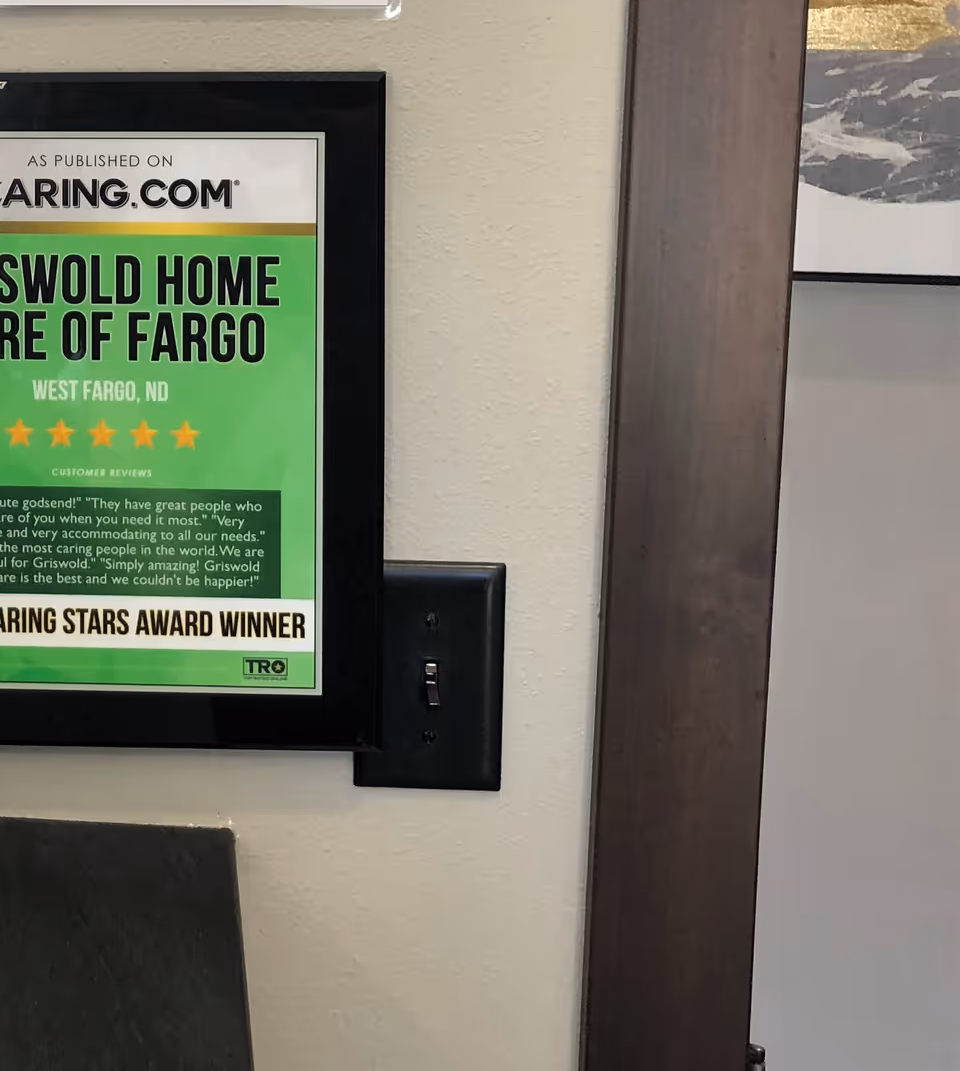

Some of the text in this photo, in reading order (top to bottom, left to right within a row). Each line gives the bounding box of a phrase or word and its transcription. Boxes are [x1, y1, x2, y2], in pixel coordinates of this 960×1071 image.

[28, 155, 173, 167] AS PUBLISHED ON
[156, 254, 280, 306] HOME
[61, 310, 114, 361] OF
[127, 311, 266, 364] FARGO
[32, 380, 169, 403] WEST FARGO, ND
[52, 468, 152, 478] CUSTOMER REVIEWS
[125, 499, 151, 510] have
[155, 502, 186, 513] great
[191, 500, 231, 513] people
[235, 501, 262, 512] who
[18, 512, 30, 523] of
[34, 516, 55, 526] you
[60, 513, 92, 524] when
[96, 516, 117, 527] you
[123, 514, 151, 525] need
[156, 515, 164, 525] it
[7, 527, 27, 538] and
[32, 529, 58, 541] very
[62, 530, 157, 543] accommodating
[161, 532, 173, 540] to
[178, 530, 190, 541] all
[195, 533, 217, 541] our
[0, 542, 18, 552] the
[22, 544, 52, 553] most
[56, 544, 92, 557] caring
[96, 545, 136, 557] people
[141, 545, 151, 555] in
[156, 545, 175, 555] the
[245, 549, 264, 557] are
[11, 557, 28, 568] for
[148, 561, 199, 573] amazing!
[204, 560, 260, 572] Griswold
[21, 572, 29, 582] is
[33, 572, 52, 583] the
[57, 573, 82, 584] best
[86, 573, 107, 584] and
[111, 576, 129, 584] we
[133, 574, 181, 586] couldn't
[186, 575, 200, 586] be
[63, 607, 130, 635] STARS
[135, 609, 213, 636] AWARD
[220, 611, 306, 639] WINNER
